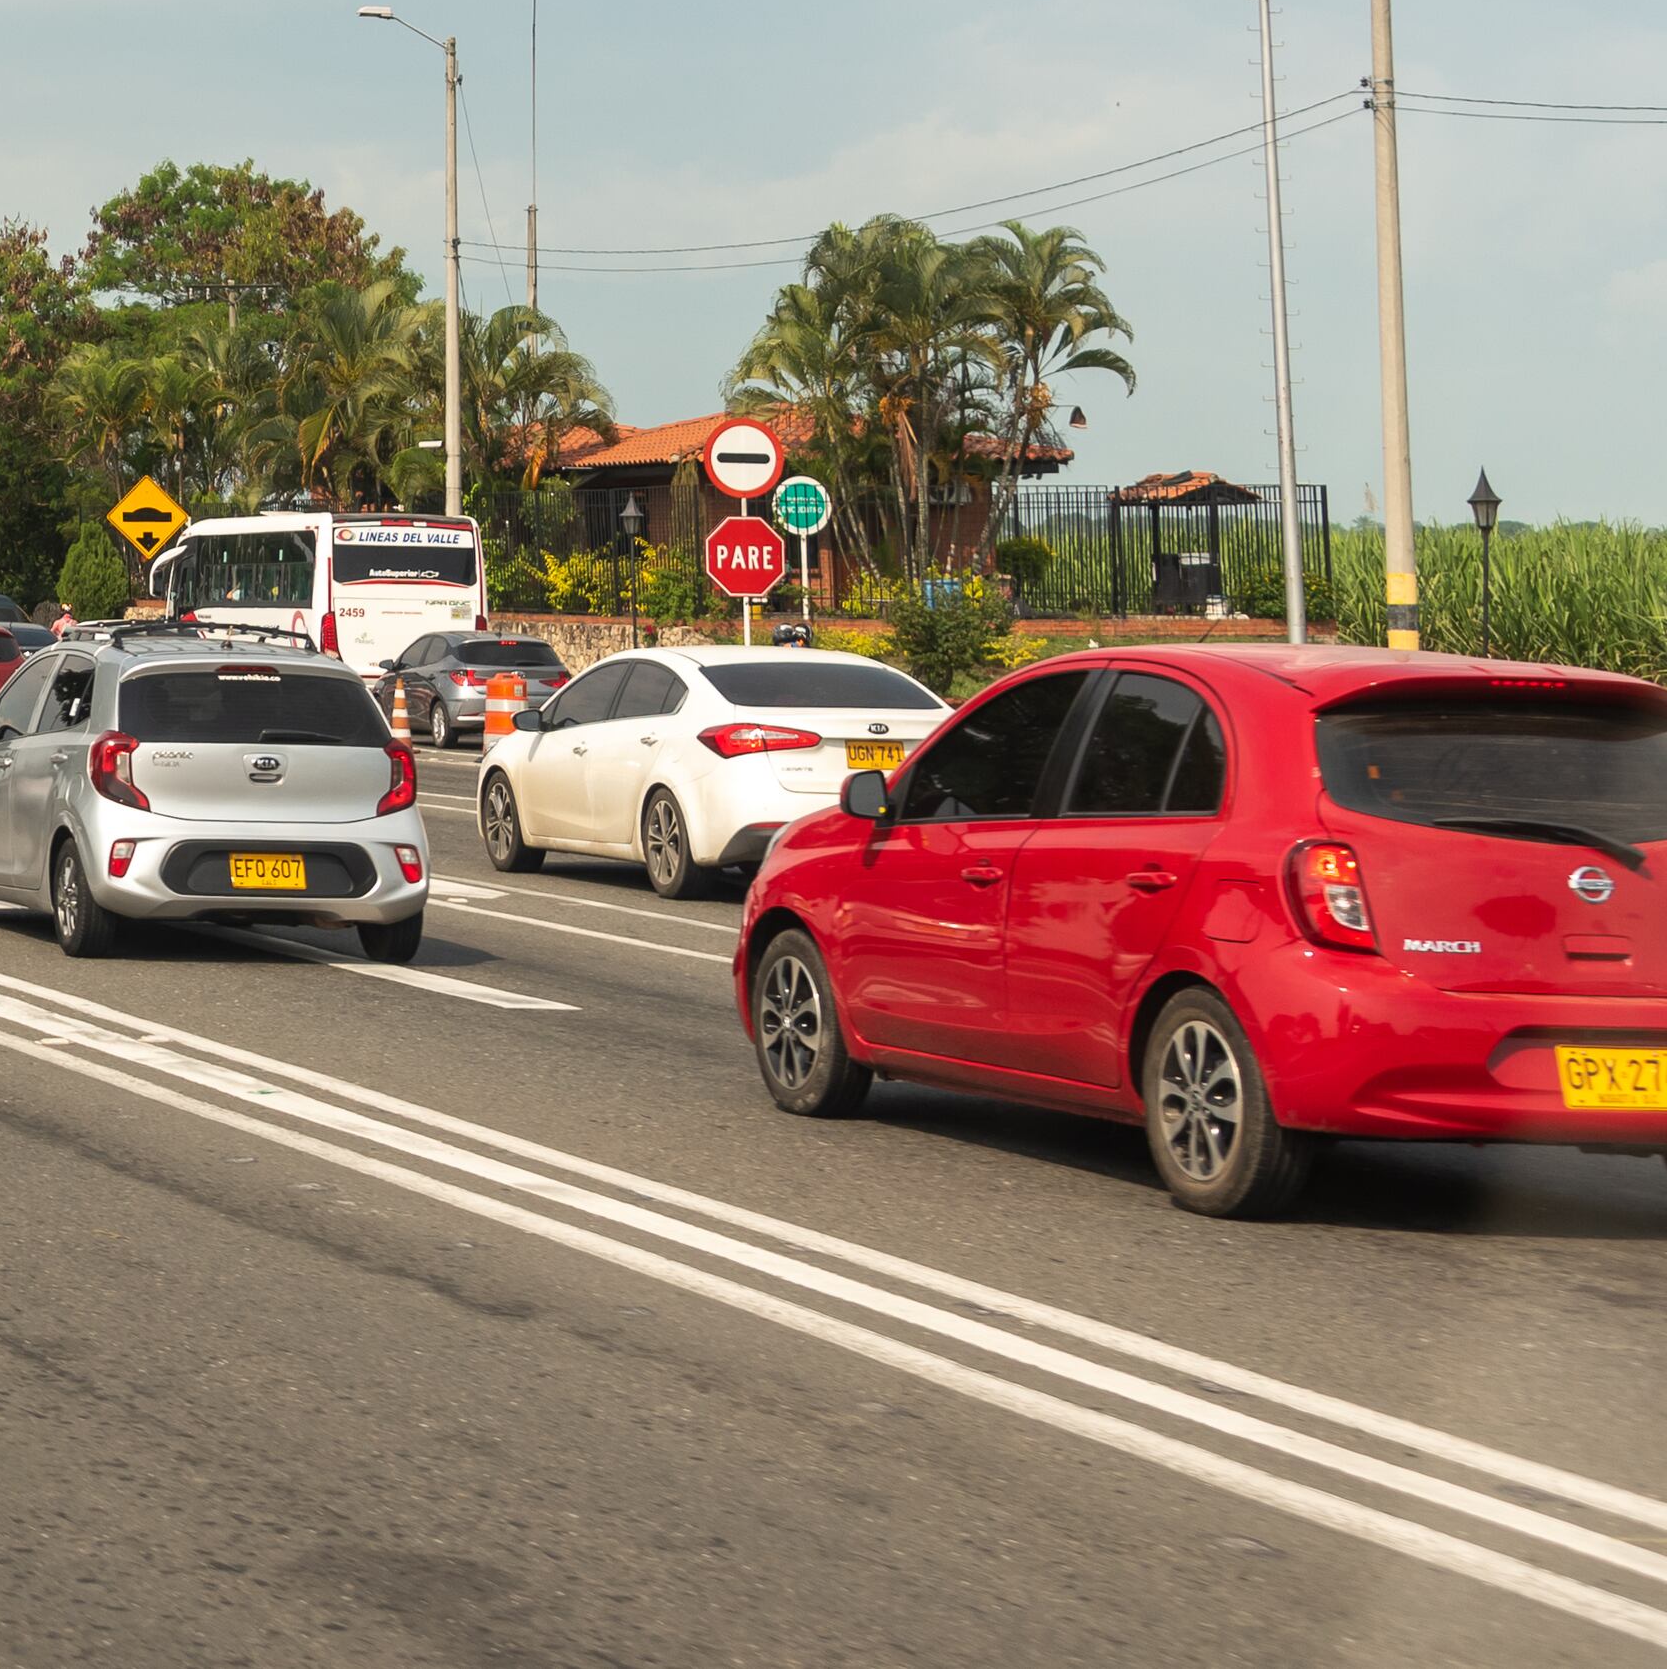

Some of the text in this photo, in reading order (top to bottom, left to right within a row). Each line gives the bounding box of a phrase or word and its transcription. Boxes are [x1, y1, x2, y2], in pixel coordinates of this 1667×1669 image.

[402, 532, 423, 543] DEL
[427, 533, 460, 544] VALLE
[716, 545, 774, 570] PARE
[339, 607, 365, 618] 2459
[870, 724, 887, 732] KIA
[847, 744, 903, 762] UGN 741
[257, 759, 276, 768] KIA
[270, 859, 301, 878] 607
[1403, 938, 1482, 953] MARCH
[1566, 1057, 1667, 1091] GPX 27
